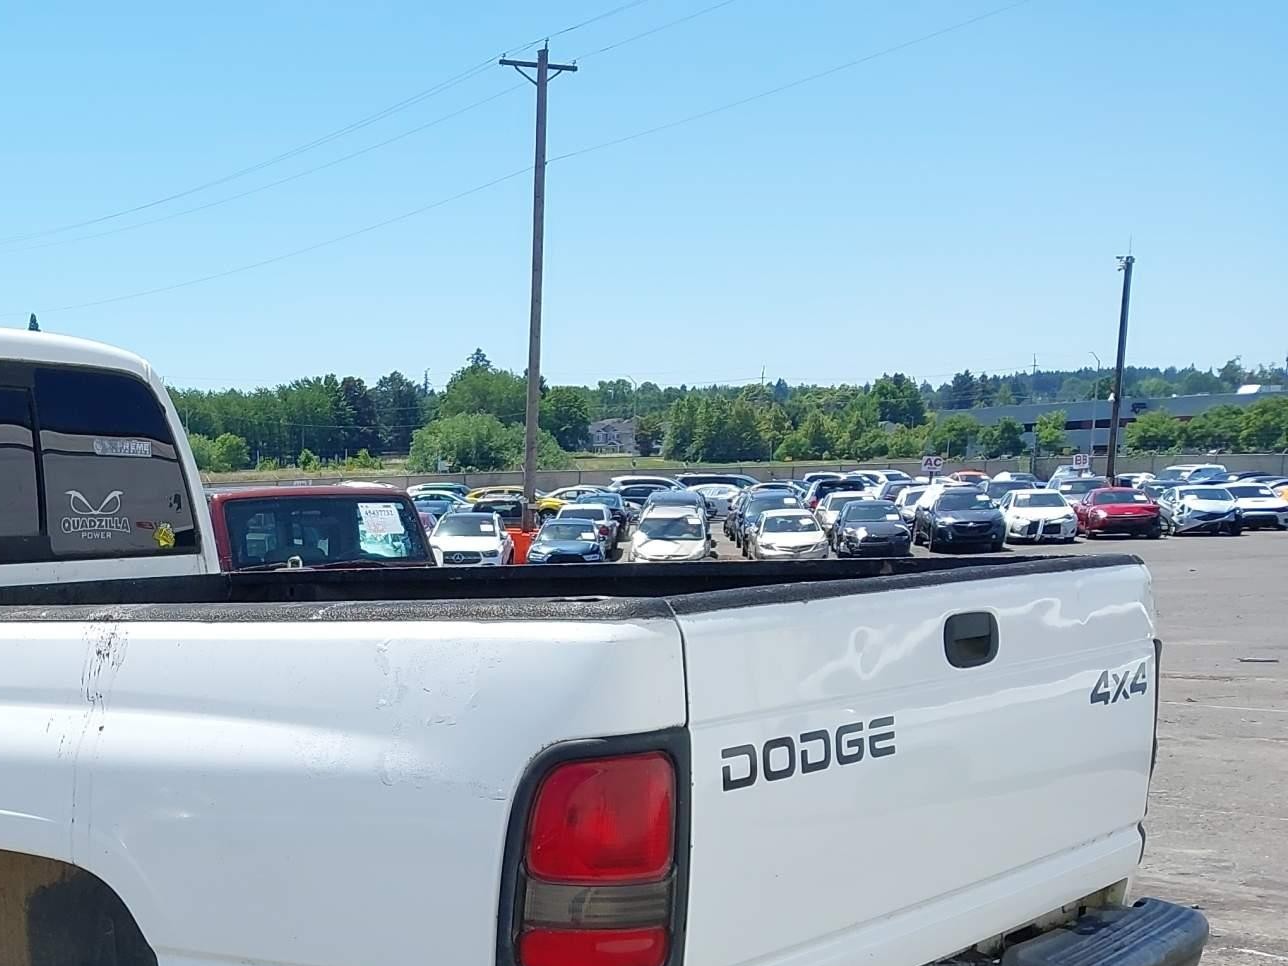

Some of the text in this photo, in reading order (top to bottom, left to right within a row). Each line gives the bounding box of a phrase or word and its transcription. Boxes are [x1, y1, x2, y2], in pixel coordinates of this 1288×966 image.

[924, 457, 942, 467] AC
[61, 517, 131, 534] QUADZILLA
[81, 532, 112, 540] POWER
[720, 715, 897, 793] DODGE
